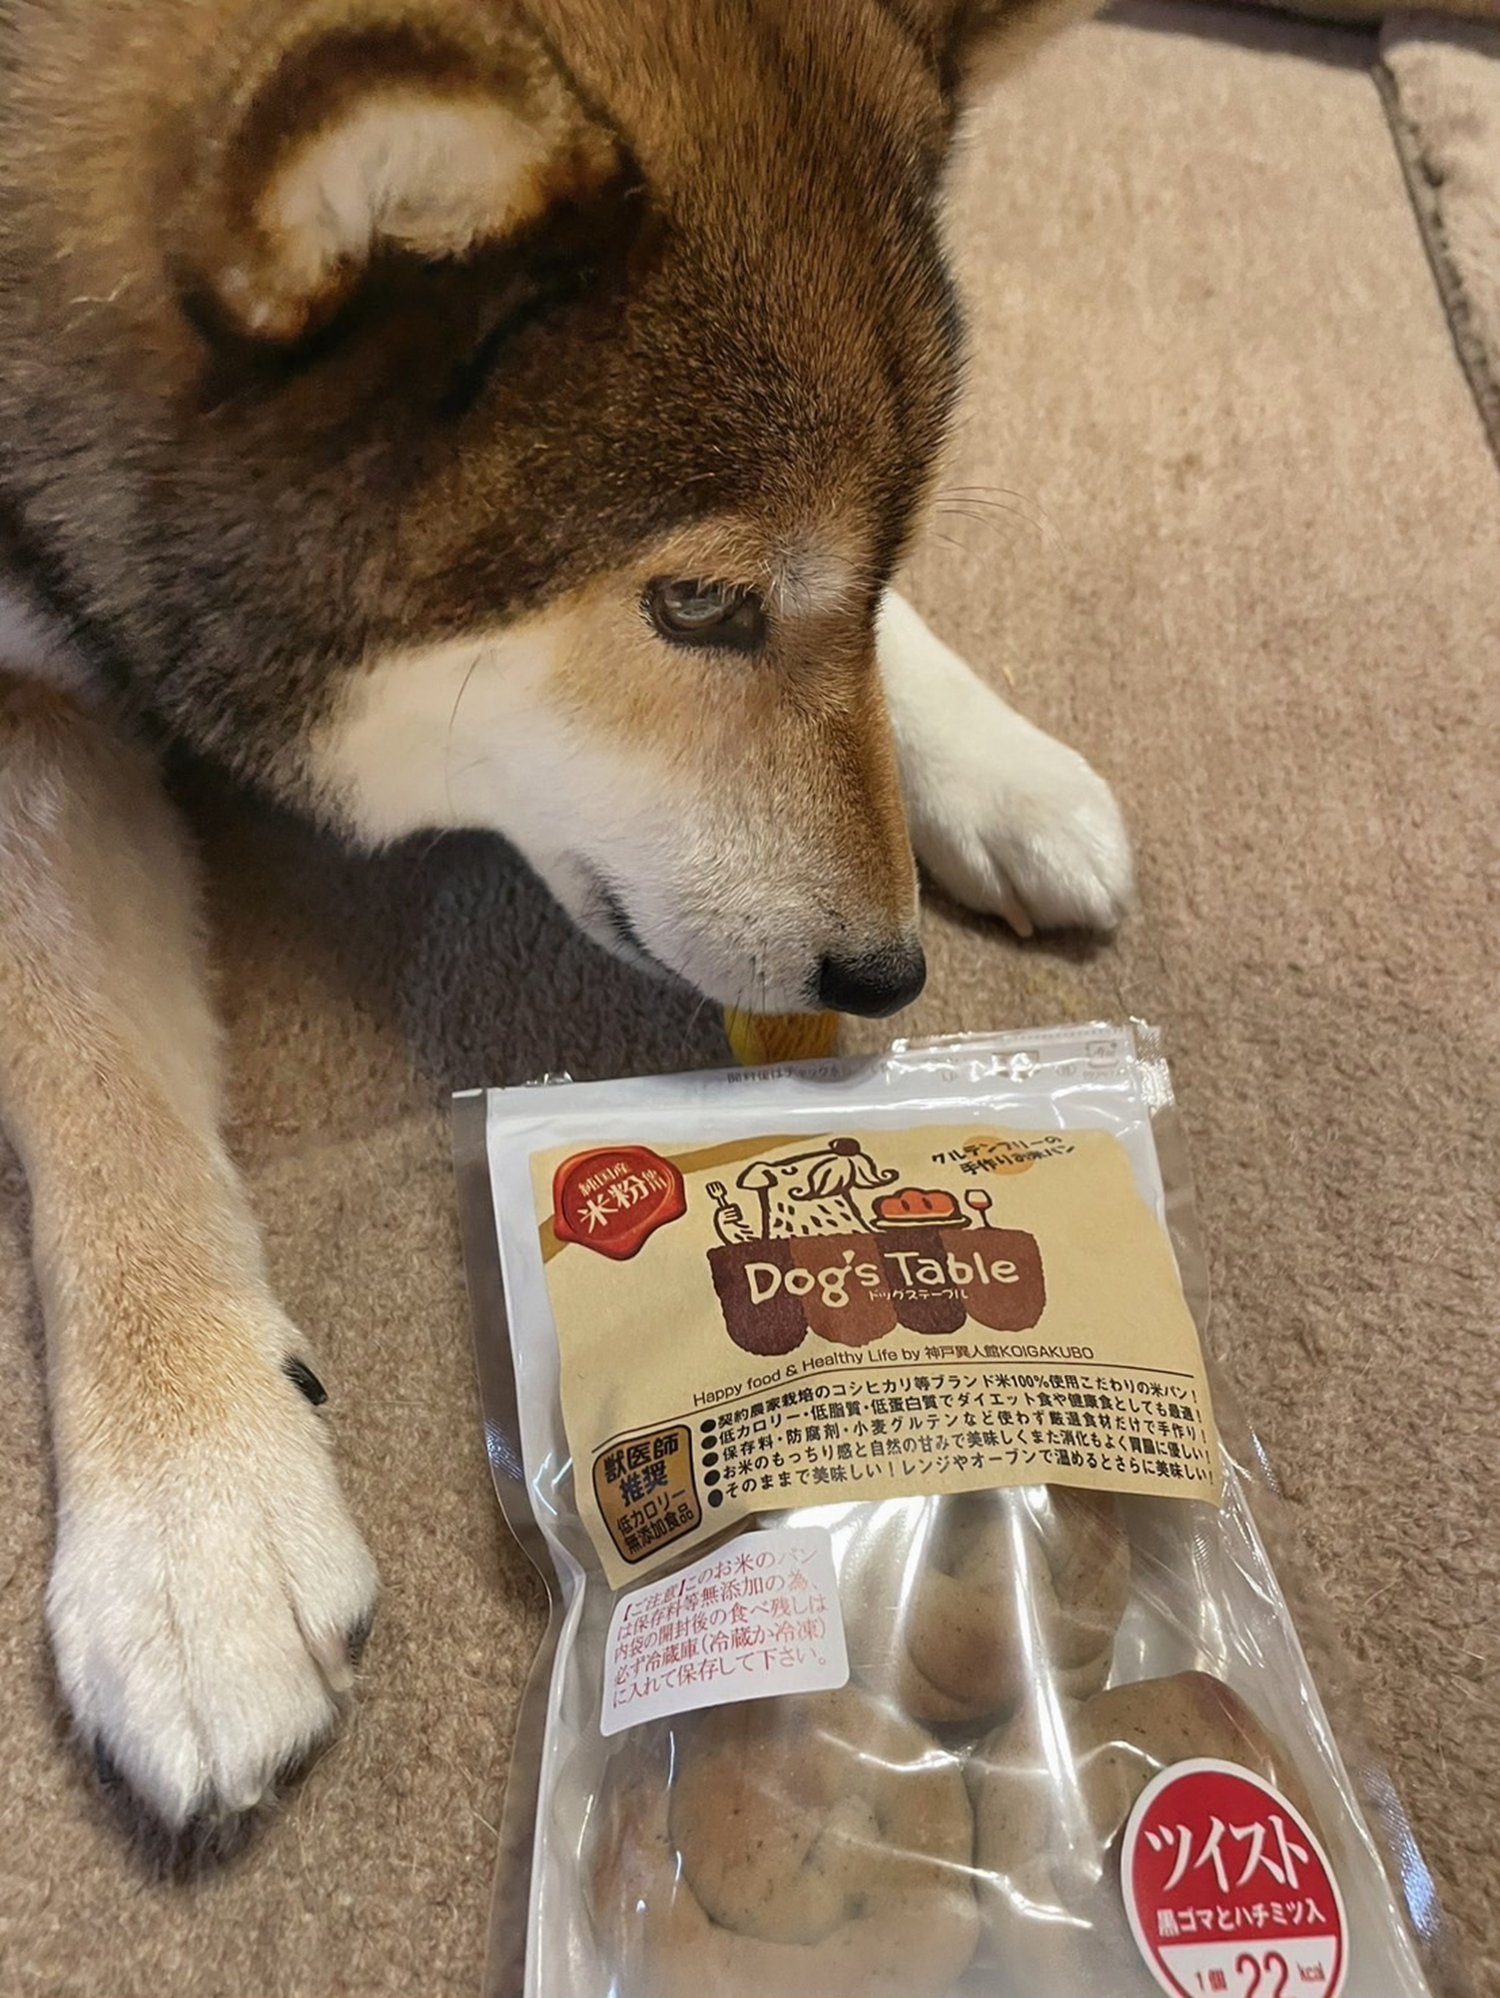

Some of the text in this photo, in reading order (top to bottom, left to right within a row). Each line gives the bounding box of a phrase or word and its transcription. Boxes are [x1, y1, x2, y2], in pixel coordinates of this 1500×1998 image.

[745, 1249, 1020, 1308] Dog's Table
[693, 1383, 742, 1408] Happy
[747, 1369, 782, 1391] food
[785, 1364, 799, 1377] &
[802, 1351, 863, 1373] Healthy
[868, 1349, 898, 1363] Life
[902, 1349, 920, 1363] by
[604, 1432, 680, 1484] 獣医師
[619, 1459, 668, 1507] 推奨
[617, 1489, 686, 1535] 低カロリー
[624, 1502, 694, 1554] 無添加食品
[1144, 1814, 1309, 1894] ツイスト
[1156, 1897, 1327, 1938] 黒ゴマとハチミツ入
[1235, 1950, 1289, 1998] 22
